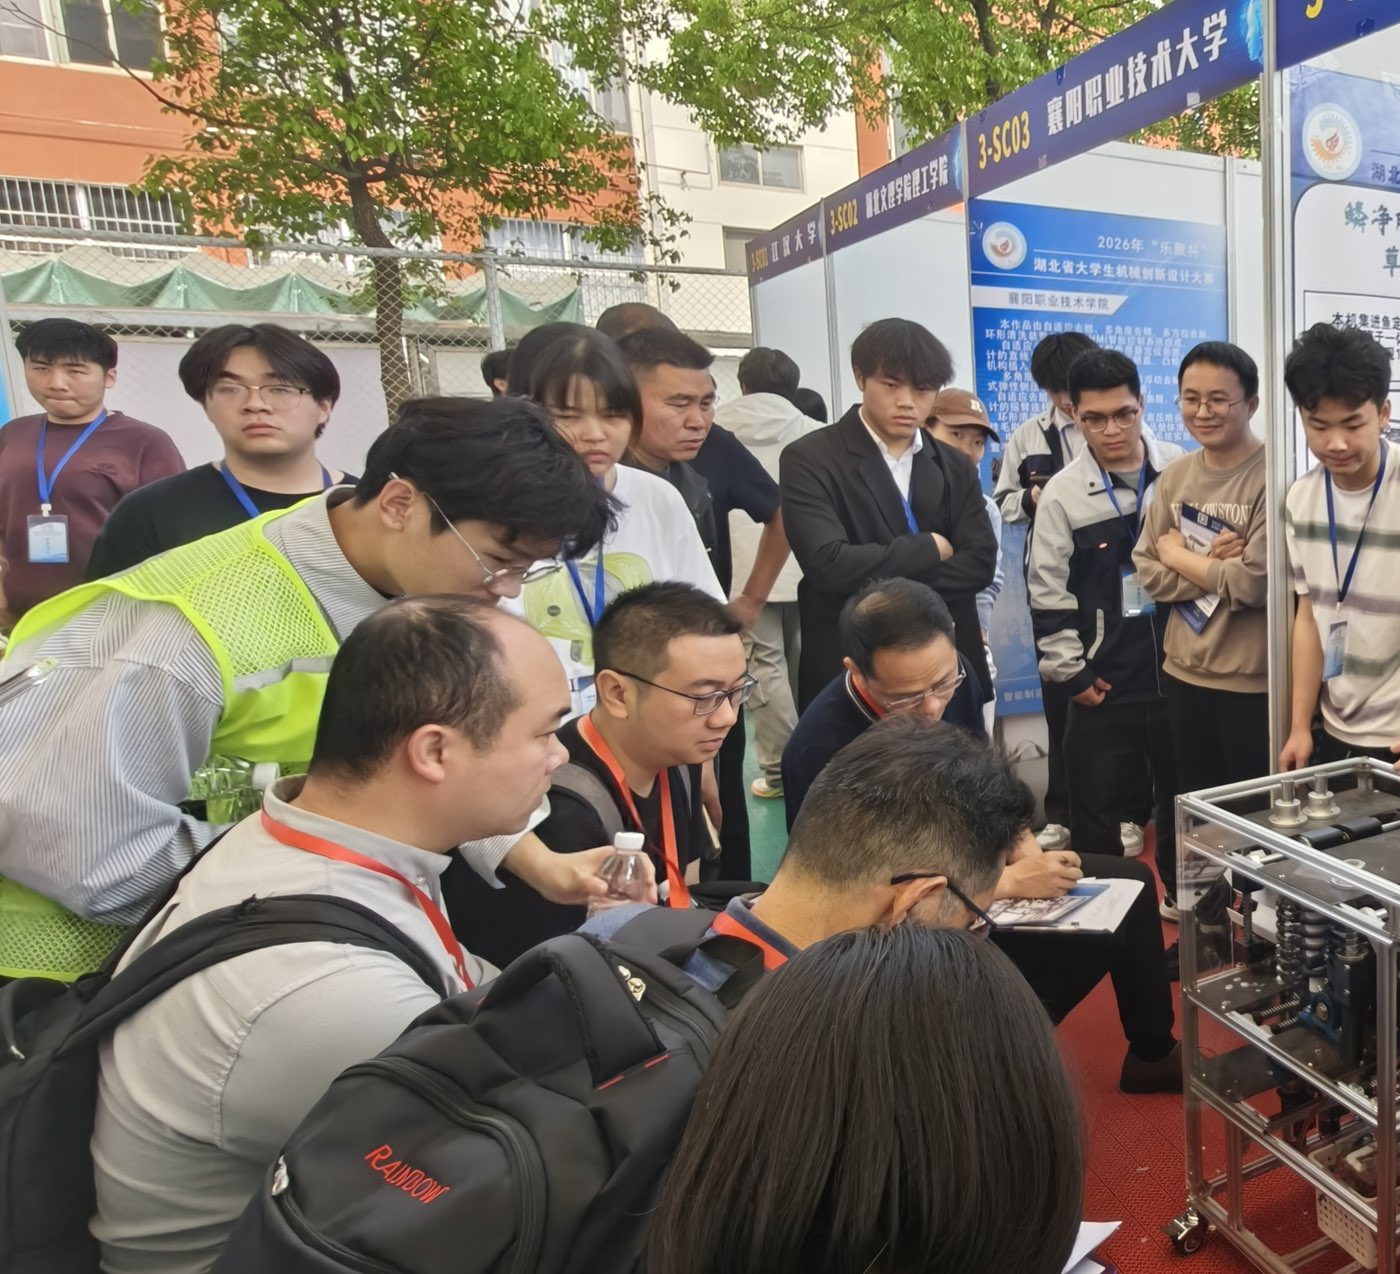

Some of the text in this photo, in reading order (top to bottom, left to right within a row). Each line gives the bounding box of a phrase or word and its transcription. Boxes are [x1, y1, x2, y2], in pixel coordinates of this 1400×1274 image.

[978, 8, 1227, 170] 3-SC03 襄阳职业技术大学
[830, 154, 949, 237] 3-SC02 湖北文理学院理工学院
[771, 220, 817, 263] 江汉大学
[1097, 236, 1144, 253] 2026年
[1033, 257, 1215, 285] 湖北省大学生机械创新设计大赛
[1008, 291, 1110, 310] 襄阳职业技术学院
[364, 1144, 450, 1204] RAINBOW
